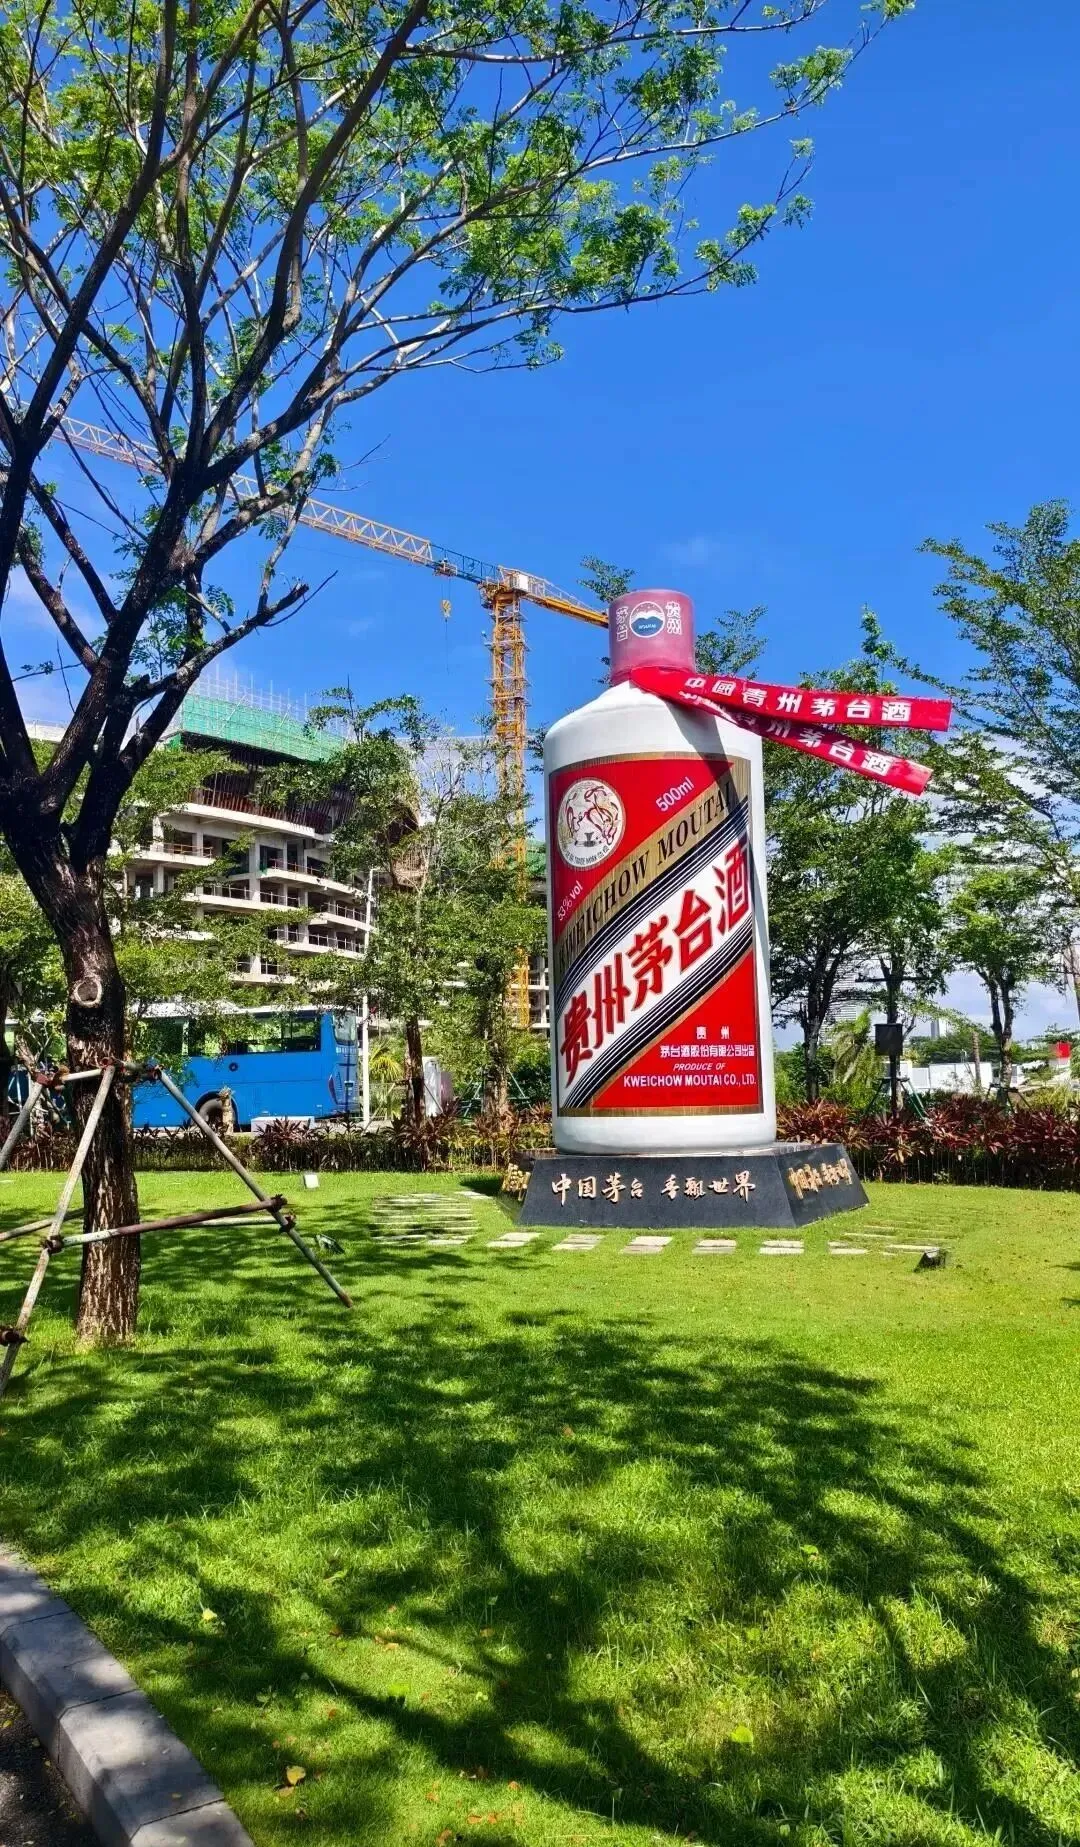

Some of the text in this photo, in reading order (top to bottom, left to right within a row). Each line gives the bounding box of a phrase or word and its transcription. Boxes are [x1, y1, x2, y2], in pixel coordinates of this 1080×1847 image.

[665, 600, 682, 636] 贵州
[655, 776, 695, 812] 500ml
[558, 780, 732, 971] KWEICHOW MOUTAI
[569, 881, 583, 903] vol
[560, 835, 749, 1089] 贵州茅台酒
[660, 1044, 755, 1058] 茅台酒股份有限公司出品
[673, 1062, 726, 1071] PRODUCE OF
[623, 1075, 683, 1088] KWEICHOW
[684, 1074, 722, 1087] MOUTAI
[551, 1172, 644, 1207] 中国茅台
